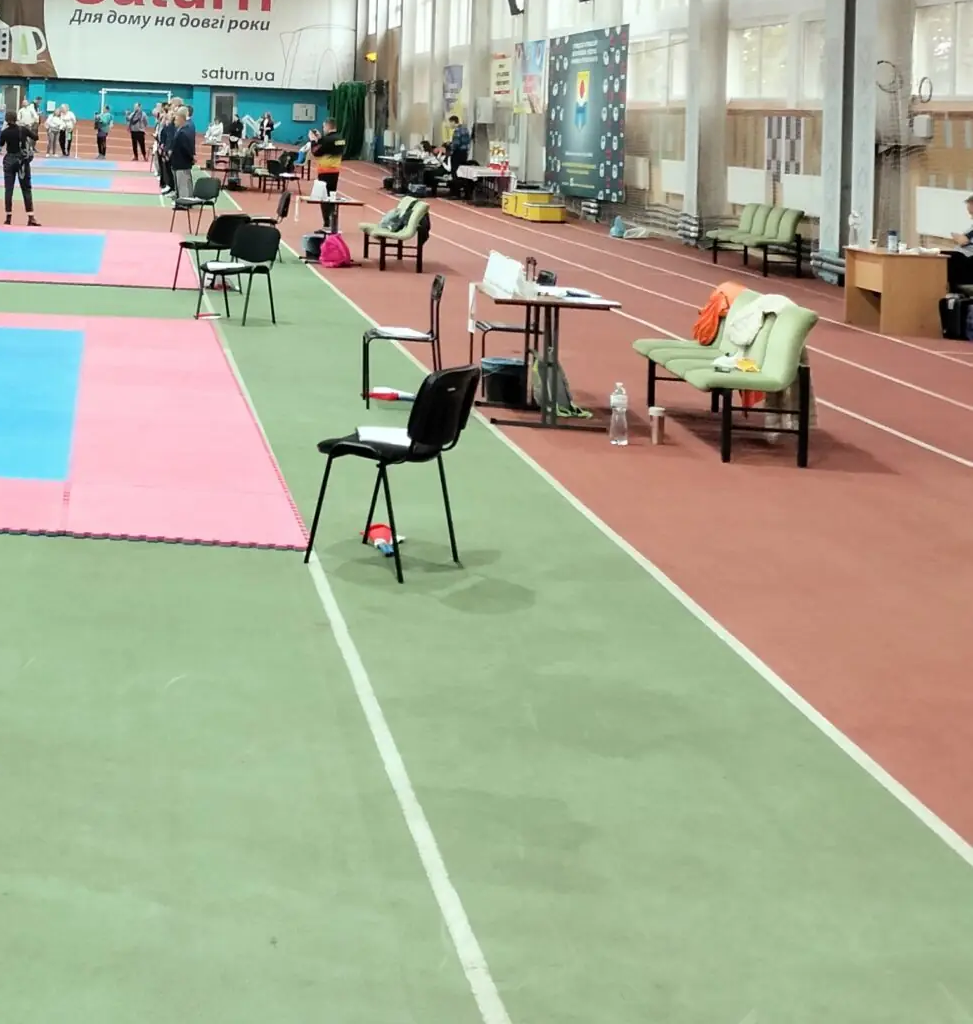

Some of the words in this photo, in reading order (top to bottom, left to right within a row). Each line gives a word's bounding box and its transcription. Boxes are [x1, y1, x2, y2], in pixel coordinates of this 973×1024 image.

[69, 8, 103, 26] Для
[106, 10, 152, 29] дому
[154, 16, 176, 28] на
[179, 12, 225, 30] довгі
[227, 18, 271, 33] роки
[201, 67, 275, 82] saturn.ua
